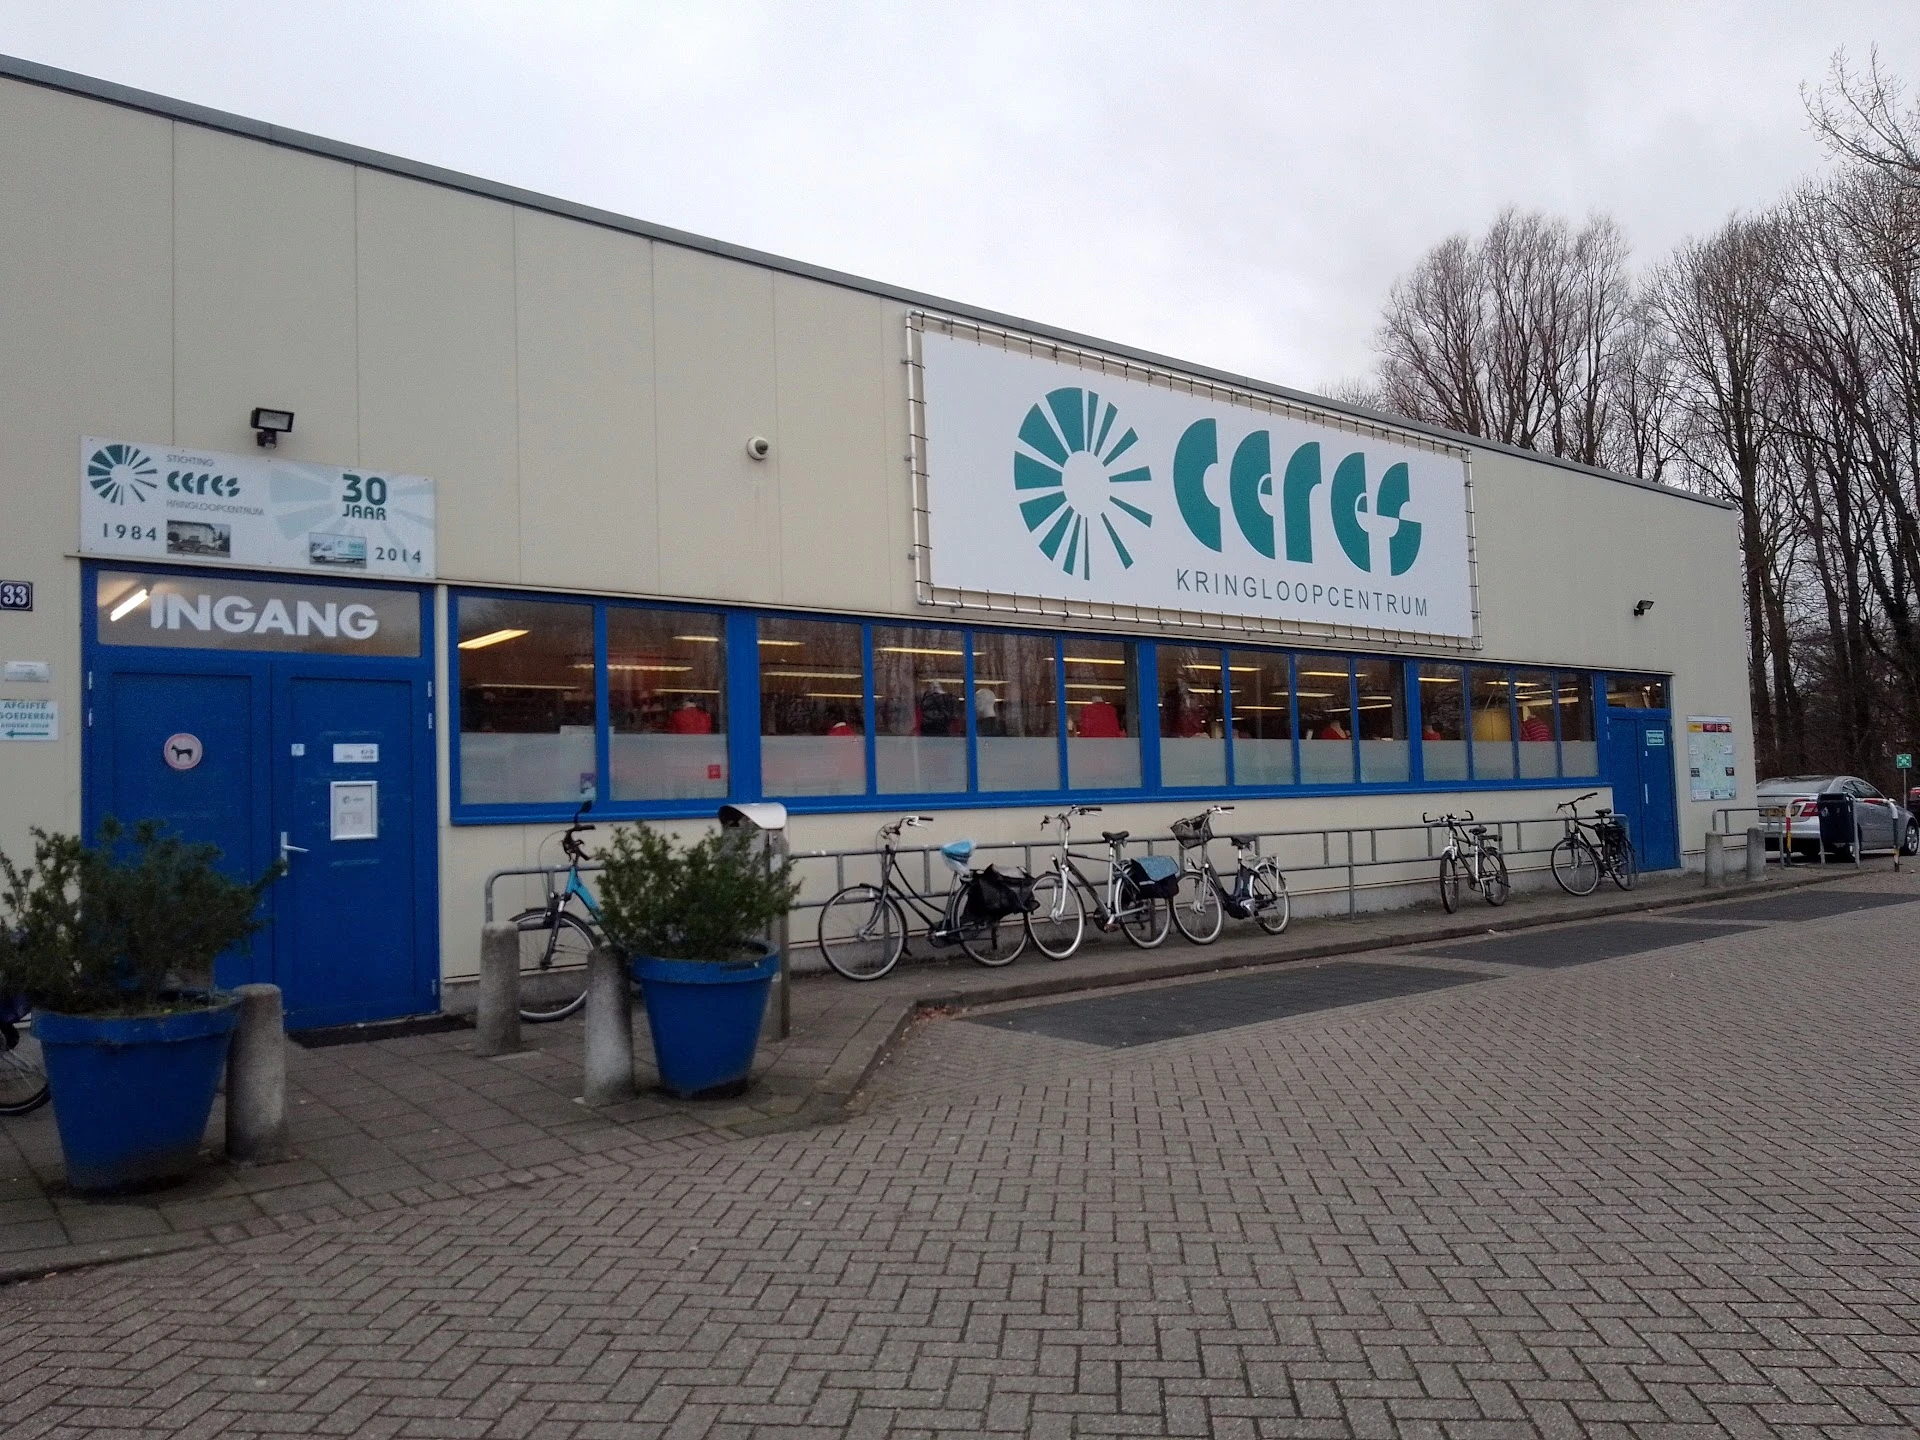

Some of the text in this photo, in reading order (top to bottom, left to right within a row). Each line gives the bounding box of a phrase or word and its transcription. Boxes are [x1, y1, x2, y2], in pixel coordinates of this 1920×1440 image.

[166, 453, 214, 467] STICHTING
[342, 473, 387, 506] 30
[166, 499, 265, 516] KRINGLOOPCENTRUM
[342, 504, 387, 521] JAAR
[103, 523, 157, 541] 1984
[375, 546, 421, 564] 2014
[2, 584, 27, 605] 33
[1176, 568, 1428, 617] KRINGLOOPCENTRUM
[150, 593, 378, 639] INGANG
[4, 702, 48, 710] AFGIFTE
